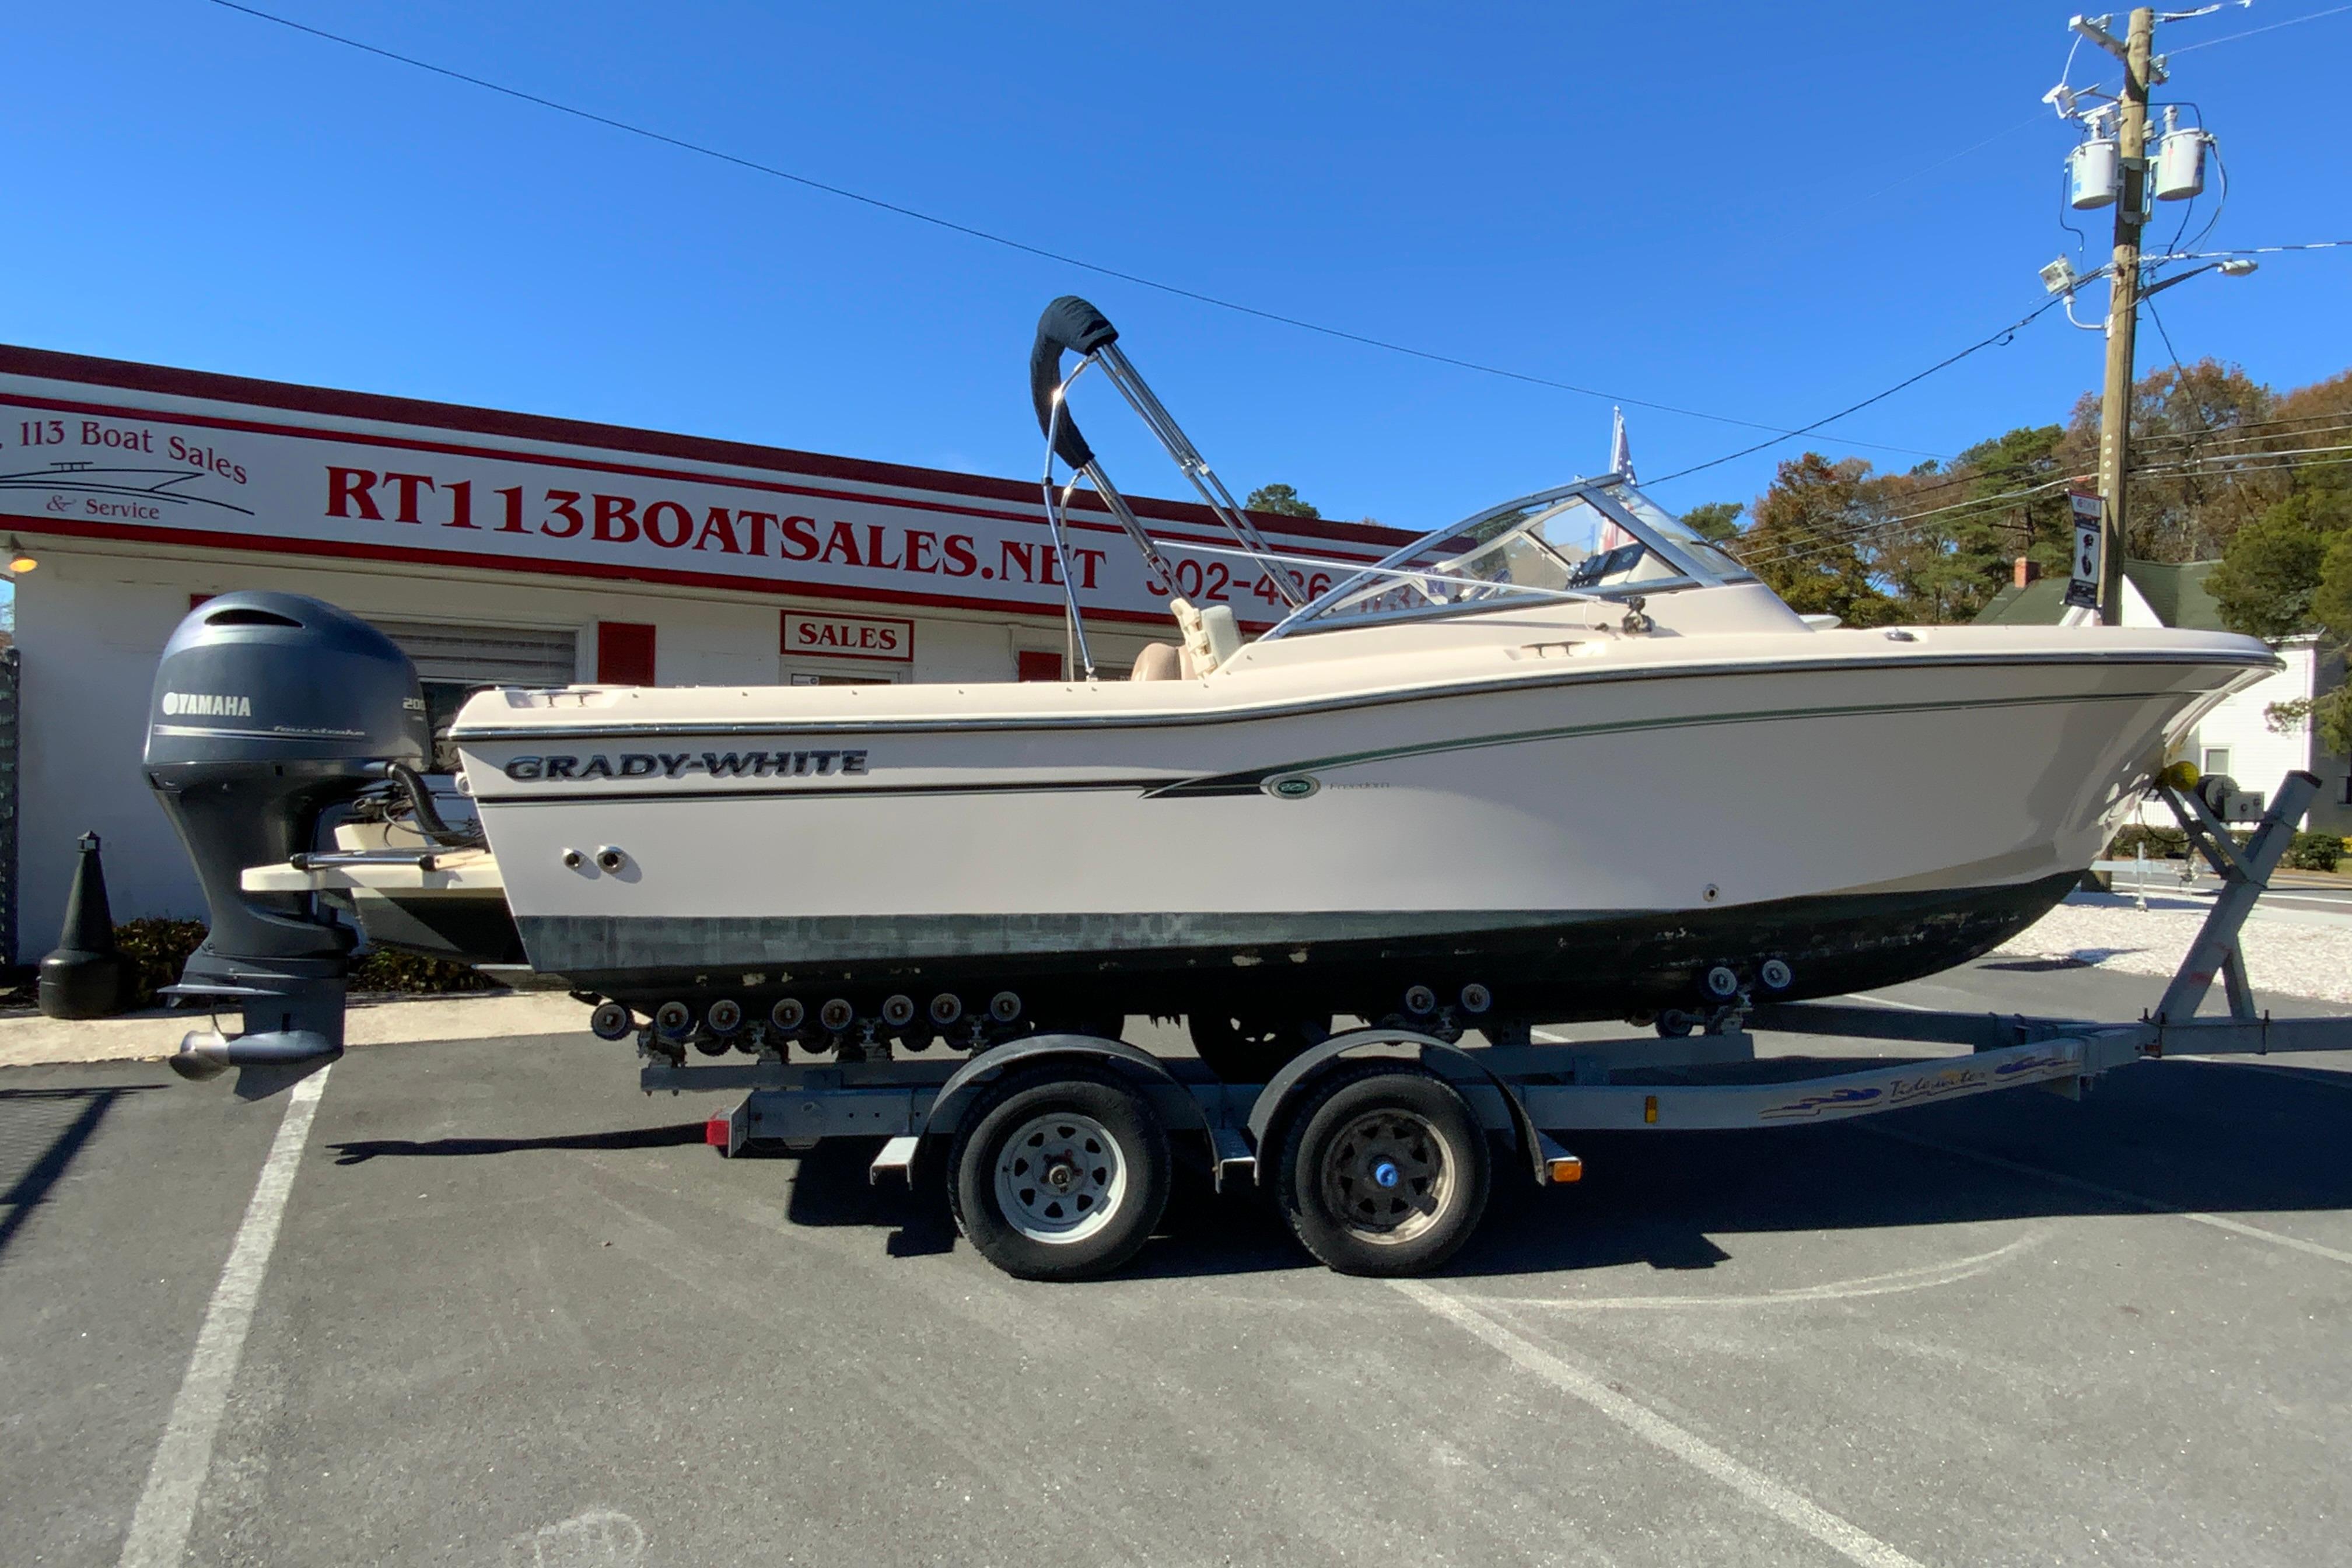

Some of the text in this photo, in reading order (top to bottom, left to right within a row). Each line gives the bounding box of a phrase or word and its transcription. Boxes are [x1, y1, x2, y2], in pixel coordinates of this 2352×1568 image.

[20, 420, 247, 485] 113 Boat Sales
[46, 495, 160, 520] & Service
[324, 466, 1107, 590] RT113BOATSALES.NET
[799, 622, 897, 650] SALES
[176, 692, 251, 716] YAMAHA
[504, 749, 869, 780] GRADY-WHITE
